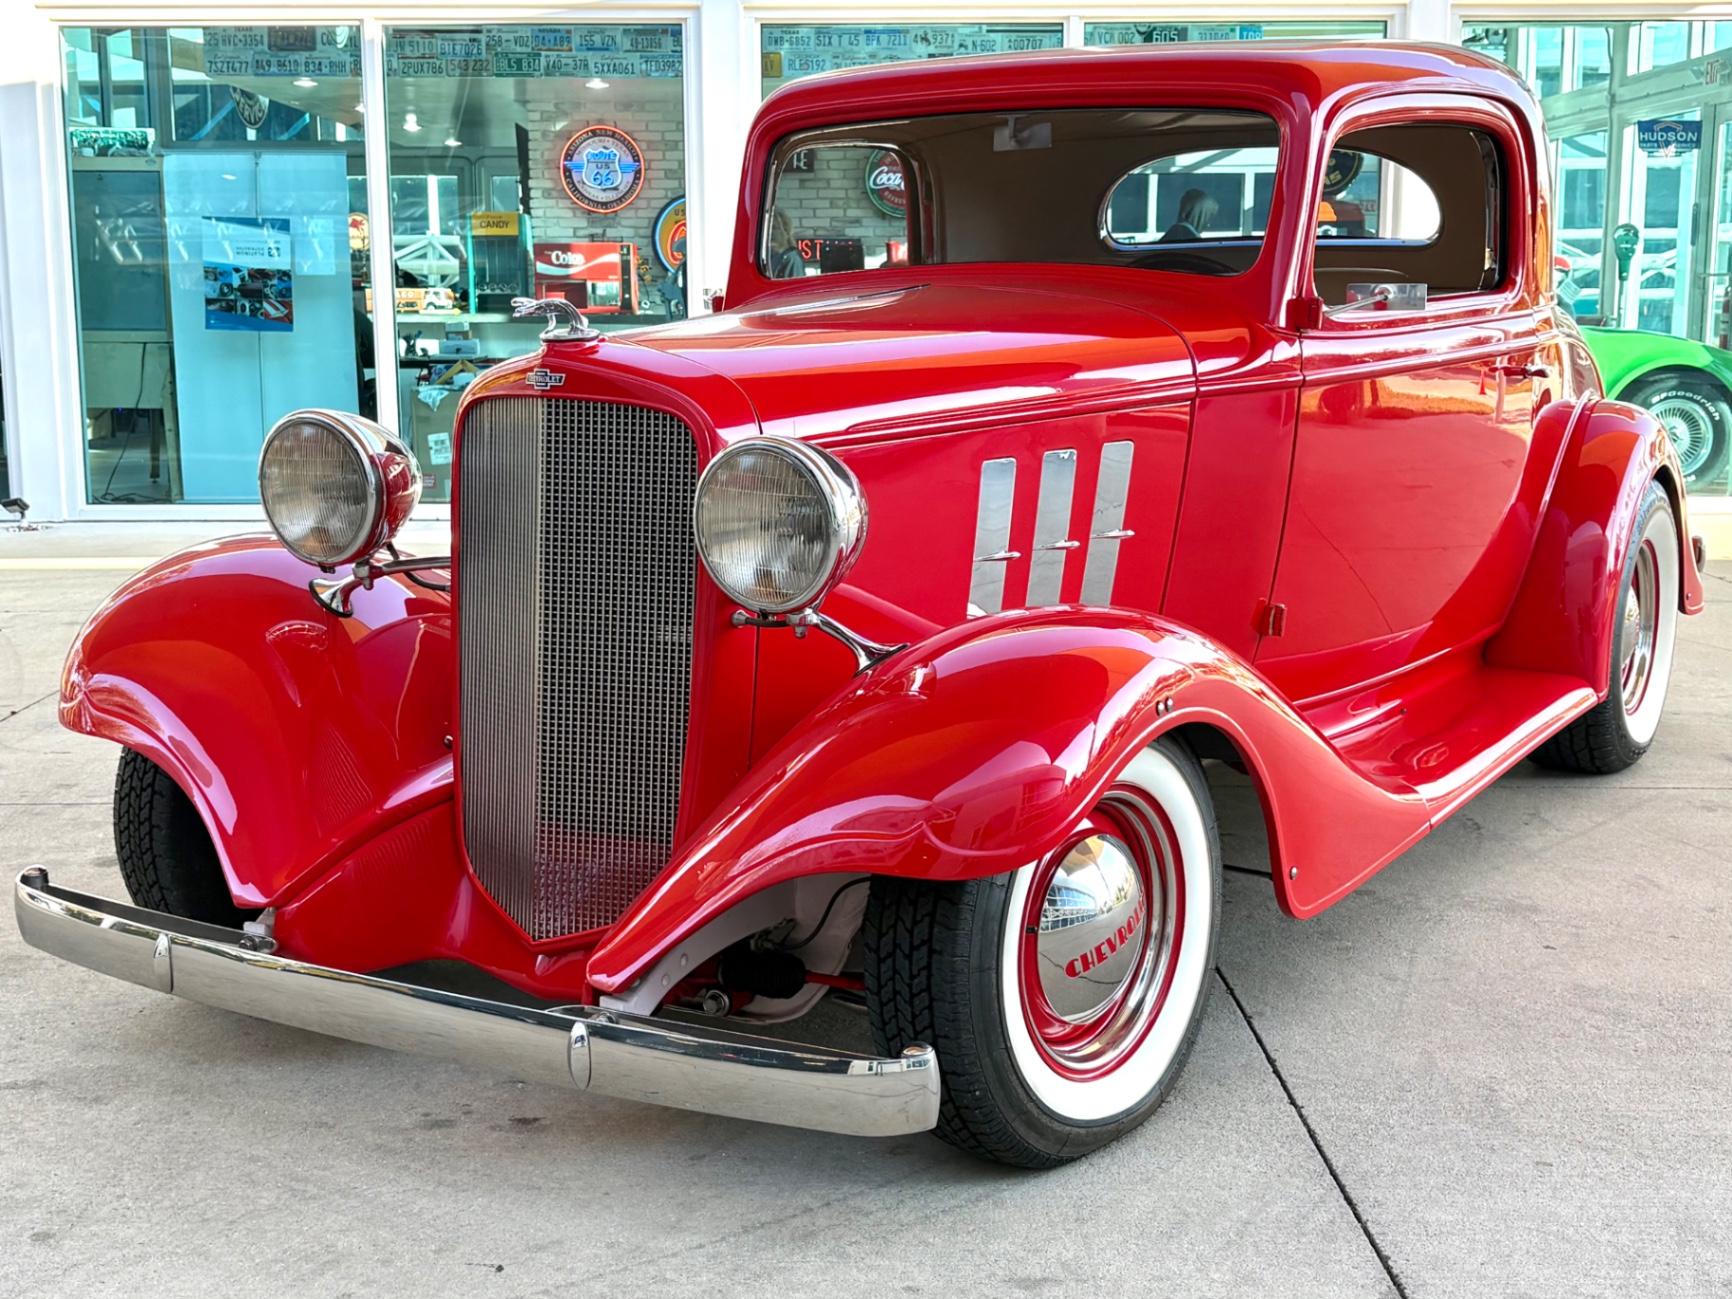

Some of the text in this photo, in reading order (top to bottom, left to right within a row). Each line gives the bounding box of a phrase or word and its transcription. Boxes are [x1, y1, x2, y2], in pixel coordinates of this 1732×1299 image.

[816, 35, 833, 47] SIX
[401, 61, 444, 74] 2PUX786
[234, 88, 267, 123] SERVIC
[1640, 131, 1698, 141] HUDSON
[592, 170, 614, 187] 66
[480, 220, 510, 229] CANDY
[551, 250, 586, 265] Coke
